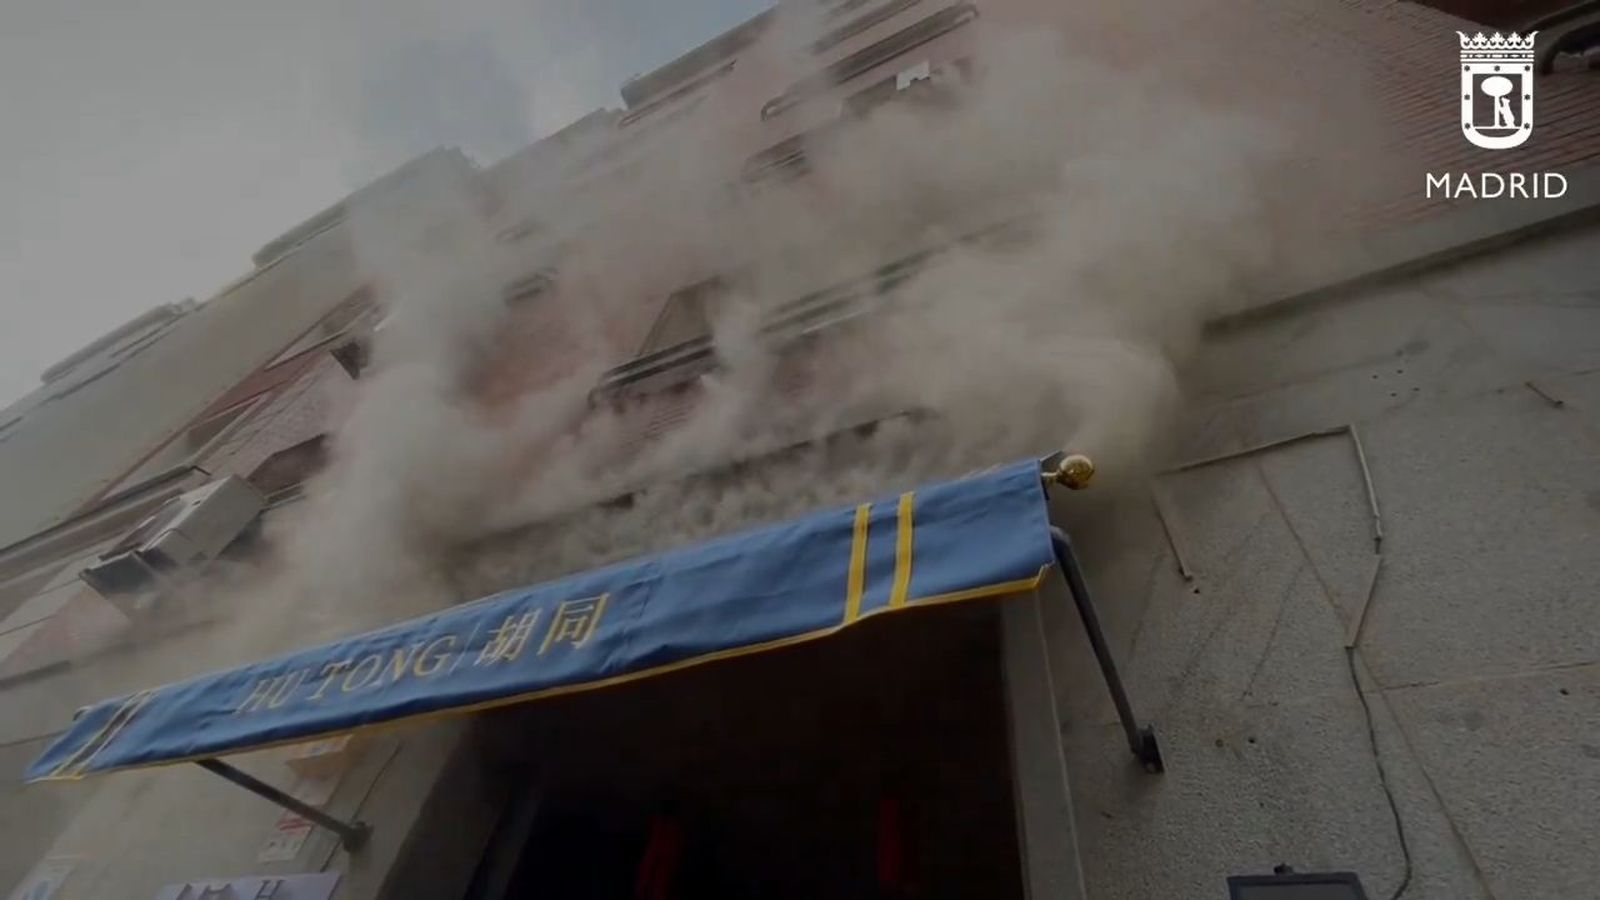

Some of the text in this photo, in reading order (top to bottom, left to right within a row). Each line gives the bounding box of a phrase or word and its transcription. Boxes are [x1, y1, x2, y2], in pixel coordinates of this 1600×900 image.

[472, 592, 611, 667] 胡同
[232, 634, 457, 716] HU TONG
